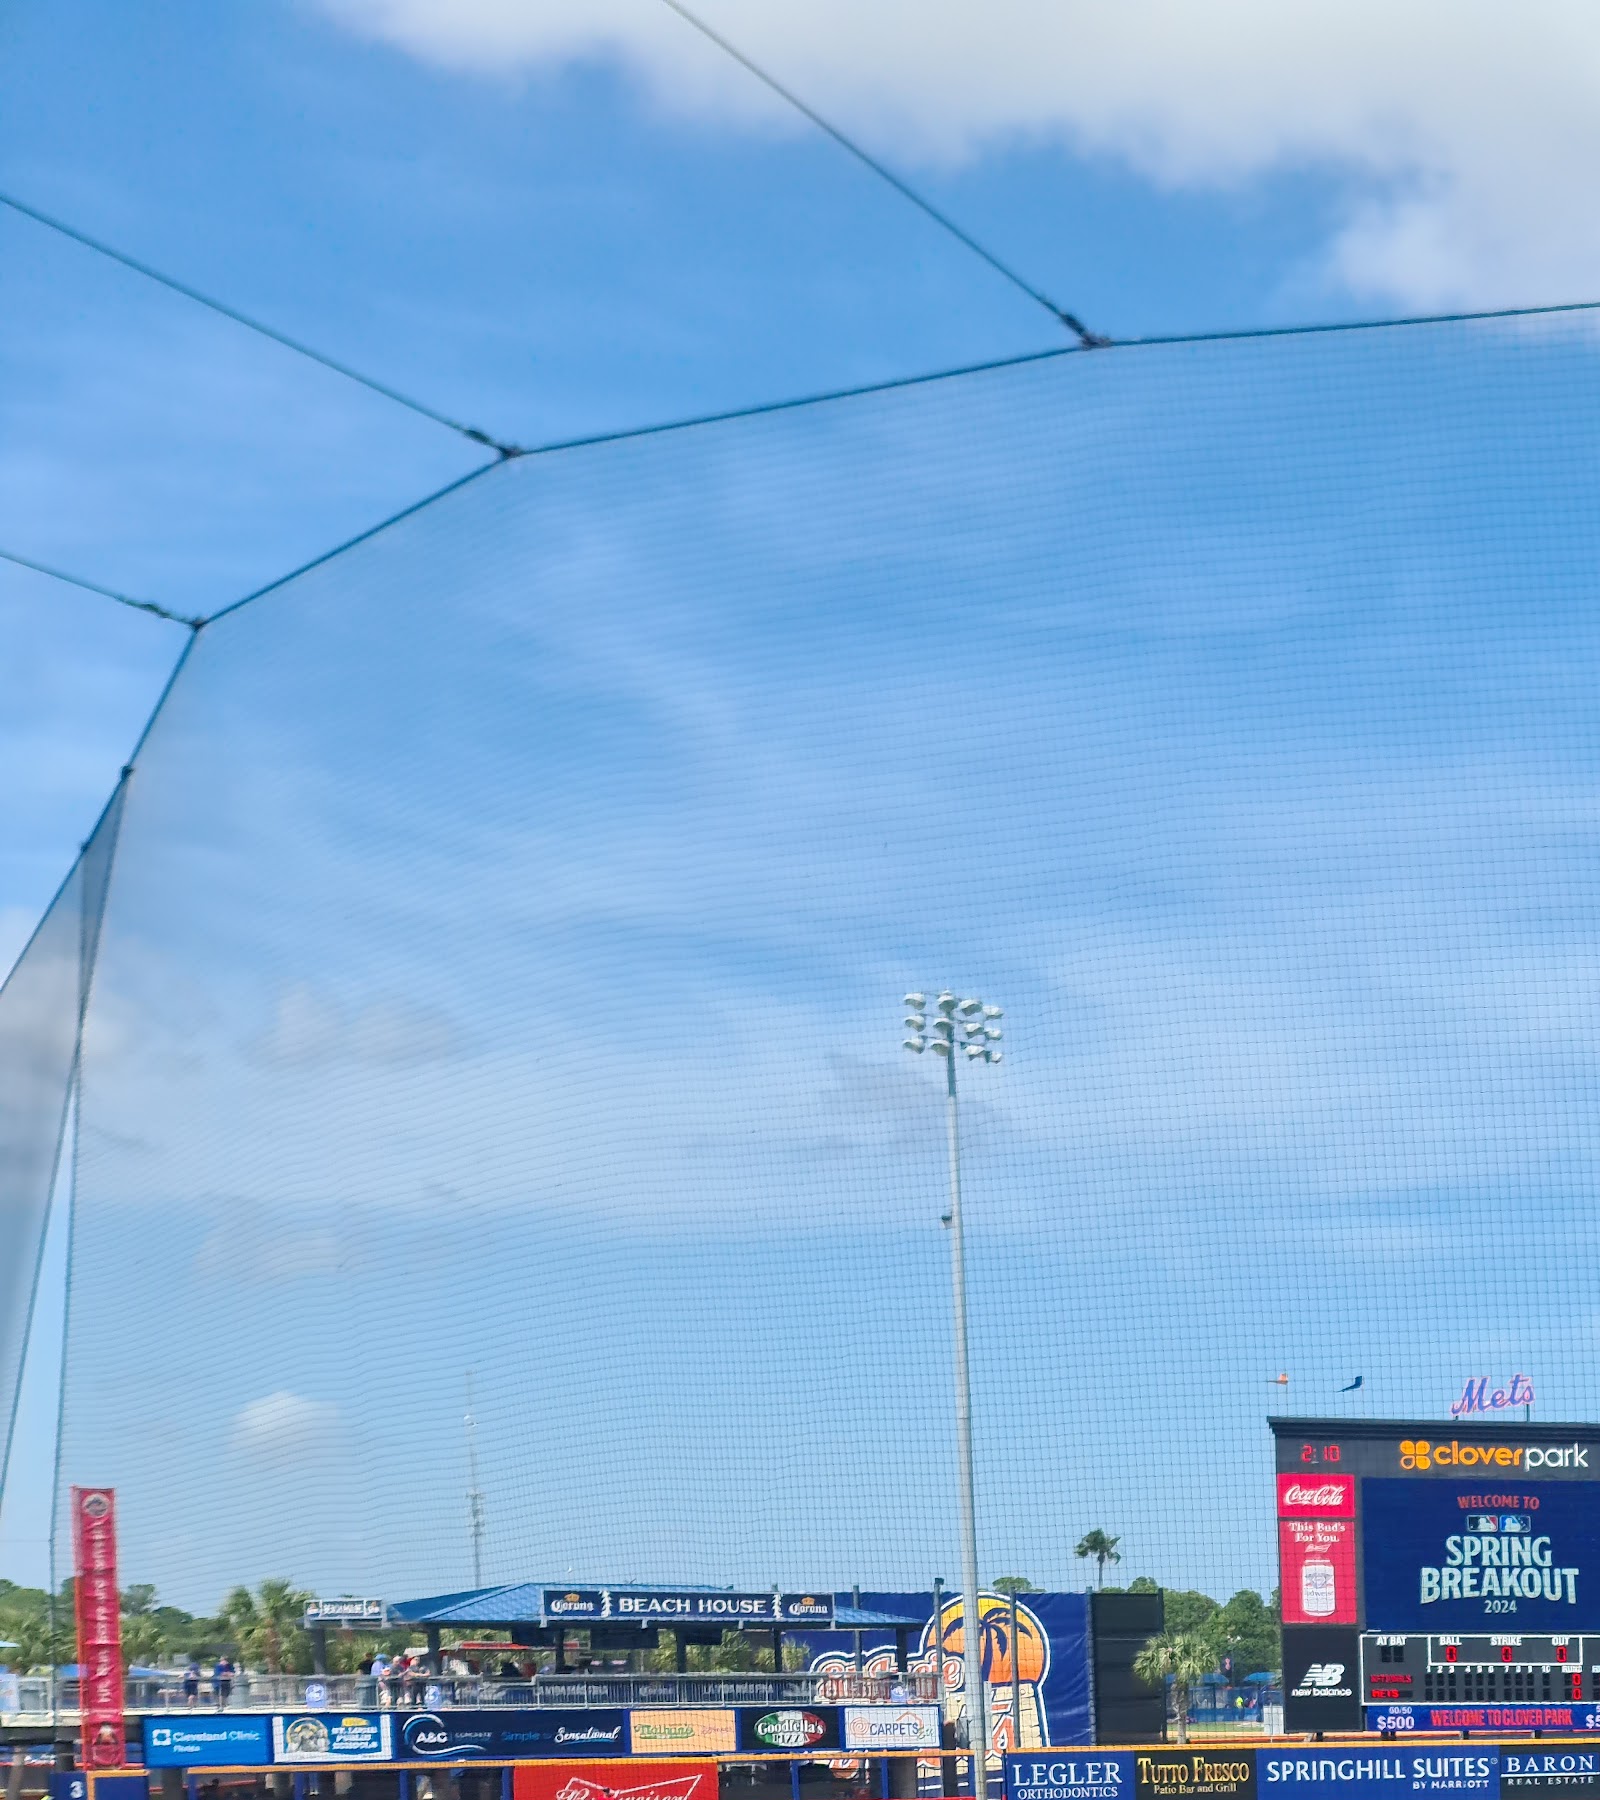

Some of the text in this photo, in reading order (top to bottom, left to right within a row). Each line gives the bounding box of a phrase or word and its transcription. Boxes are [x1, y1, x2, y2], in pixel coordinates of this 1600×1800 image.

[1451, 1374, 1535, 1416] Mets
[1457, 1496, 1539, 1509] WELCOME TO
[1289, 1522, 1346, 1532] This Bud's
[1295, 1533, 1314, 1543] For
[1445, 1536, 1552, 1566] SPRING
[1420, 1567, 1579, 1604] BREAKOUT
[551, 1599, 594, 1613] Corona
[619, 1598, 766, 1614] BEACH HOUSE
[789, 1601, 828, 1615] Corona
[1484, 1600, 1517, 1613] 2024
[1376, 1637, 1407, 1646] AT BAT
[1440, 1637, 1462, 1646] BALL
[1490, 1637, 1522, 1646] STRIKE
[1552, 1637, 1570, 1646] OUT
[1292, 1687, 1352, 1697] new balance
[1377, 1716, 1415, 1730] $500
[1431, 1709, 1572, 1726] WELCOME TO CLOVER PARK
[758, 1719, 823, 1735] Goodfella's
[869, 1722, 918, 1736] CARPETS
[172, 1730, 261, 1743] Cleveland Clinic
[502, 1726, 622, 1744] Simple Sensational
[772, 1733, 809, 1745] PIZZA
[1137, 1756, 1250, 1784] TUTTO FRESCO
[1267, 1757, 1490, 1782] SPRINGHILL SUITES
[1507, 1755, 1594, 1772] BARON
[1012, 1762, 1122, 1787] LEGLER
[1507, 1776, 1594, 1786] REAL ESTATE
[1153, 1783, 1237, 1795] Patio Bar and Grill
[1413, 1780, 1489, 1790] BY MARRIOTT
[1018, 1786, 1118, 1800] ORTHODONTICS
